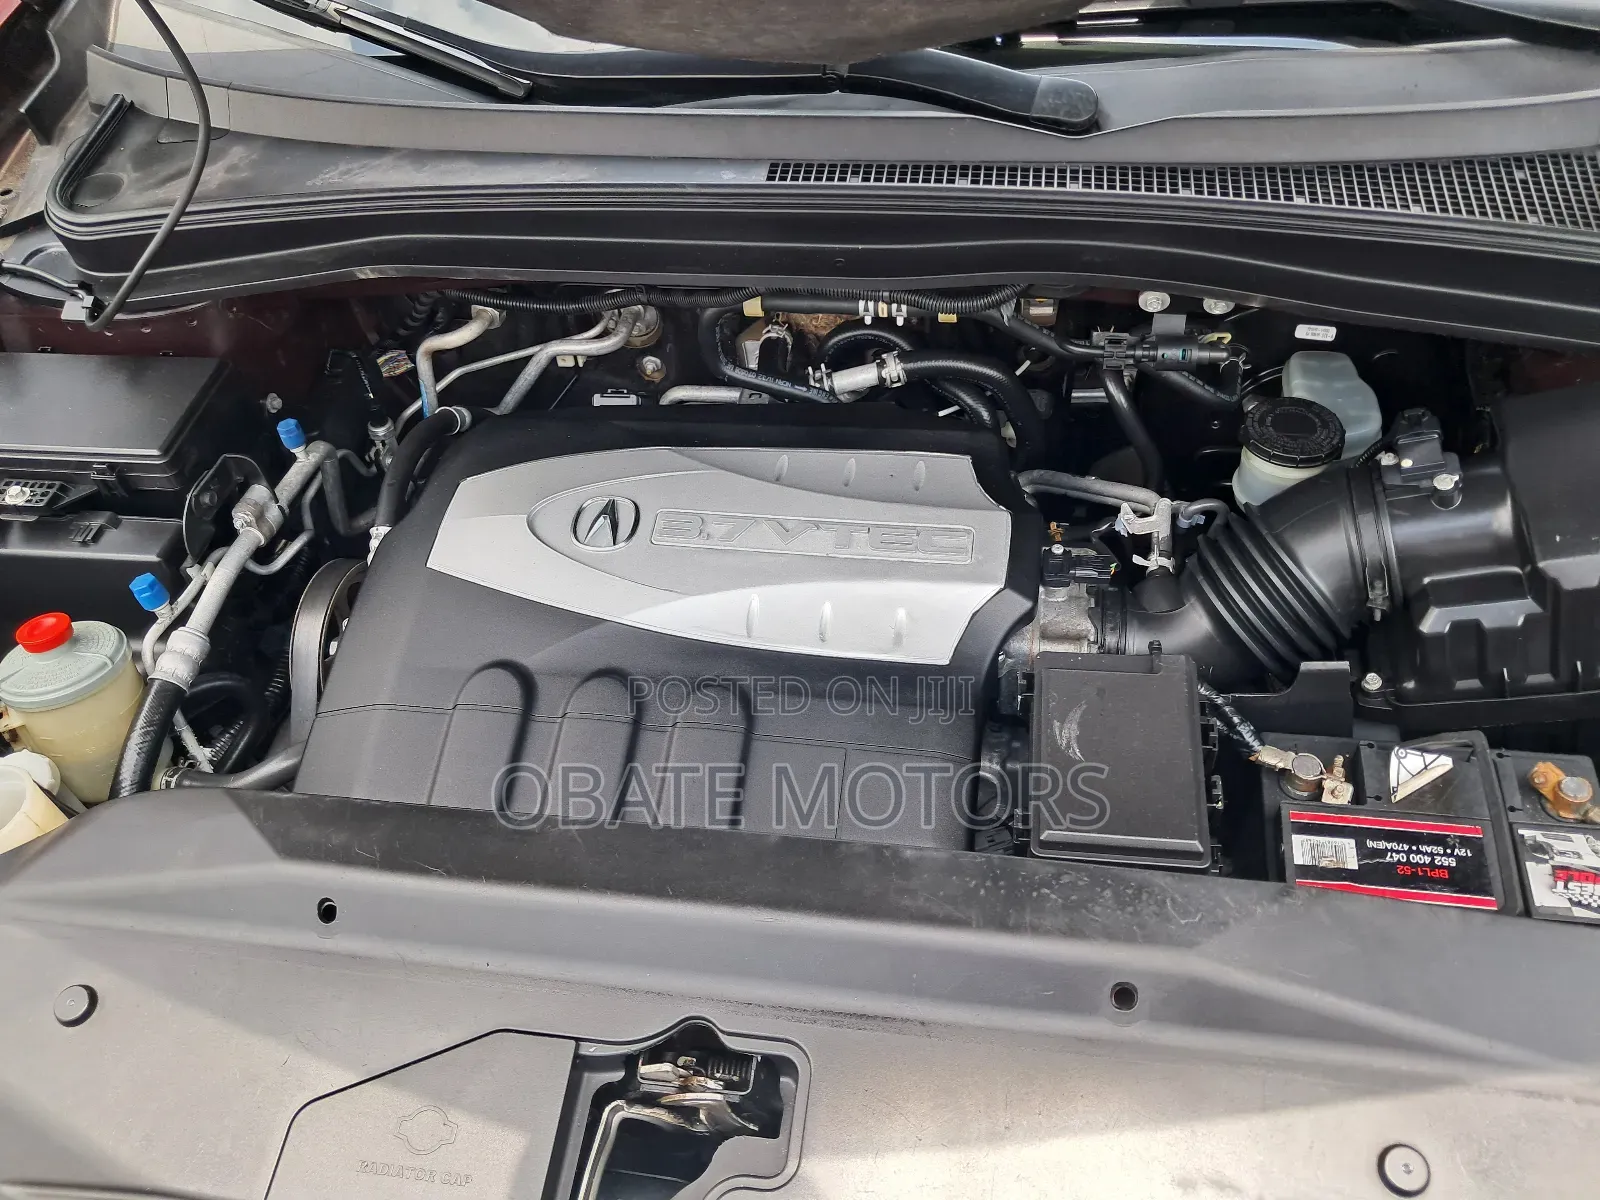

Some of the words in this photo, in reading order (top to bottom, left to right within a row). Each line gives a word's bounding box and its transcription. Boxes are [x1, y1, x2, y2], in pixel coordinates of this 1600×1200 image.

[1366, 838, 1410, 851] 470A(EN)
[1419, 844, 1444, 854] 52Ah
[1386, 851, 1407, 863] 047
[1454, 848, 1472, 857] 12V
[1409, 853, 1432, 865] 400
[1434, 855, 1456, 867] 552
[1396, 864, 1449, 879] BPL1-52
[356, 1159, 438, 1183] RADIATOR
[440, 1171, 474, 1187] CAP
